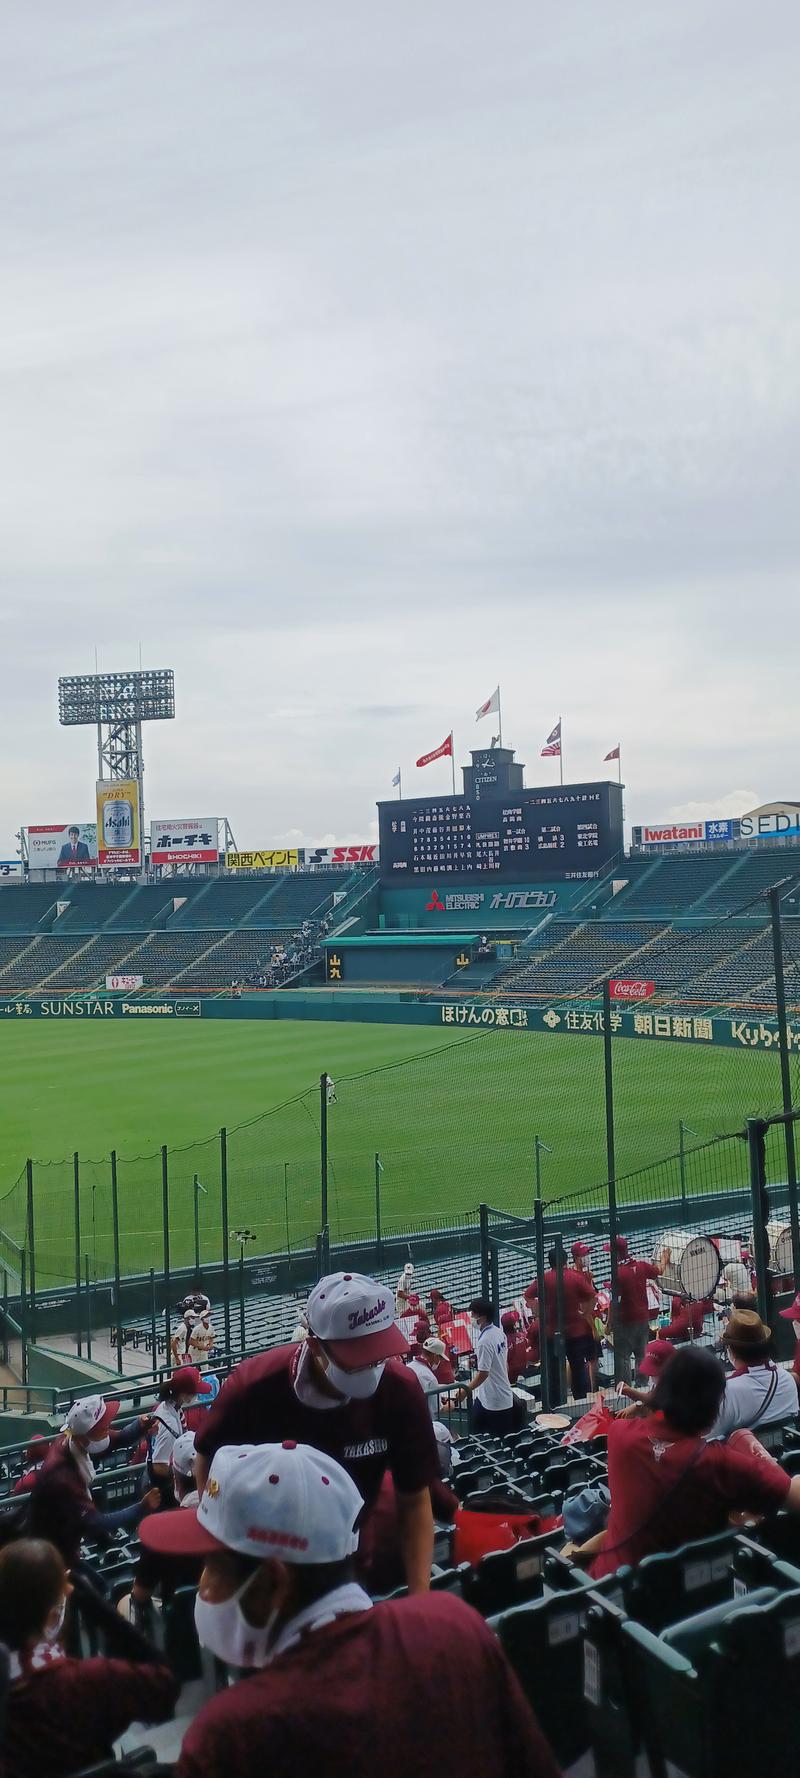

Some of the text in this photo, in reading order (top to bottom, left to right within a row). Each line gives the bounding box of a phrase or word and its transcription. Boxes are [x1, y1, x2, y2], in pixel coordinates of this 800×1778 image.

[644, 824, 702, 841] Iwatani
[708, 822, 728, 834] 水素
[156, 833, 212, 848] ホーチキ
[227, 851, 297, 866] 関西ペイント
[332, 846, 376, 862] SSK
[446, 893, 484, 902] MITSUBISHI
[446, 901, 480, 910] ELECTRIC
[330, 954, 341, 978] 山九
[614, 981, 648, 996] Coca-Cola
[41, 1001, 114, 1015] SUNSTAR
[122, 1003, 173, 1014] Panasonic
[564, 1011, 622, 1031] 住友化学
[634, 1014, 713, 1040] 朝日新聞
[348, 1298, 386, 1330] Takasho
[344, 1439, 388, 1458] TAKASHO
